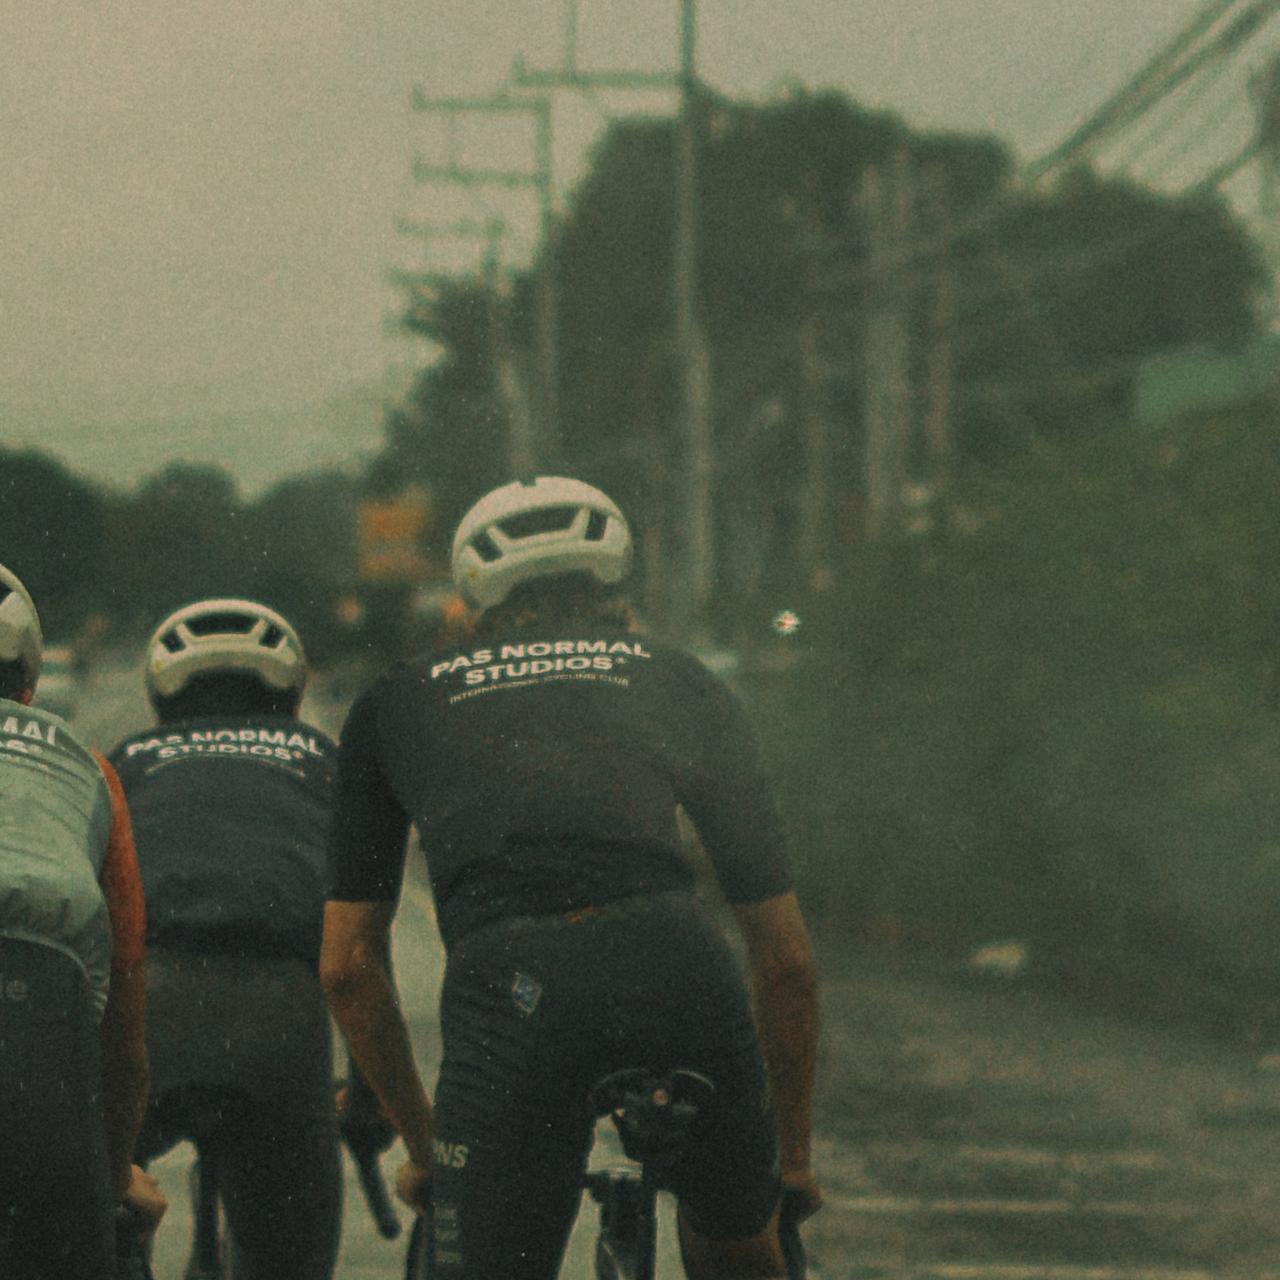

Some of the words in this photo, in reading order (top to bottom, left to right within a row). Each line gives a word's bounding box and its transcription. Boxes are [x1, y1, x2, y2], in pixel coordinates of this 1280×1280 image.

[431, 649, 493, 678] PAS
[501, 640, 651, 659] NORMAL
[191, 730, 324, 756] NORMAL
